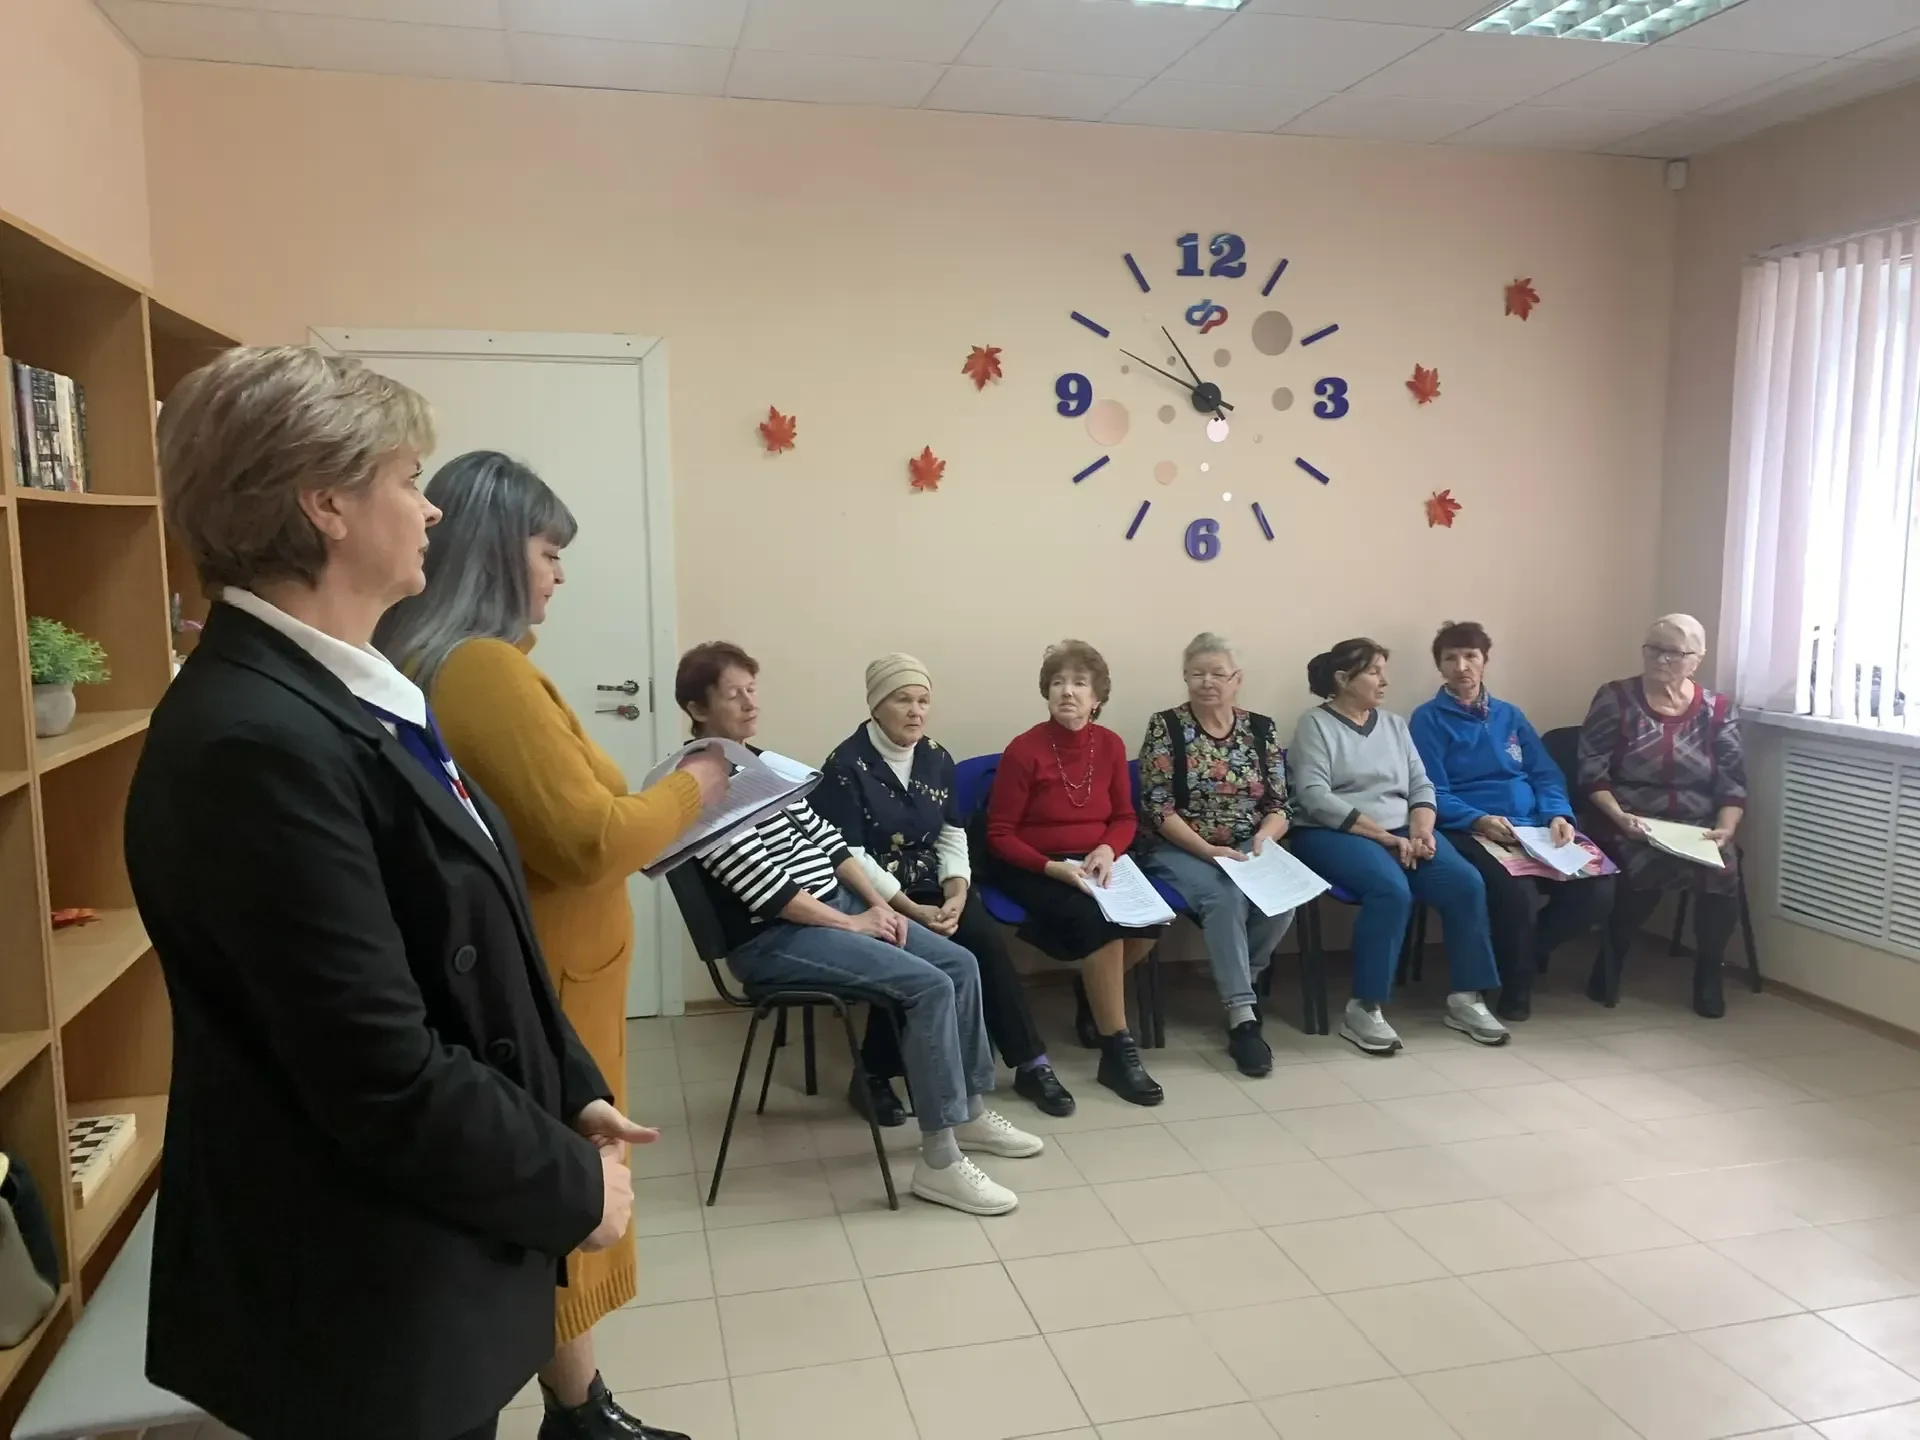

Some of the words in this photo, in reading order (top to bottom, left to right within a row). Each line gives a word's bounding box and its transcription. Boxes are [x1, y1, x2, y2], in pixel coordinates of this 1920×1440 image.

[1176, 233, 1247, 278] 12
[1055, 373, 1092, 417] 9
[1313, 377, 1350, 419] 3
[1184, 518, 1221, 561] 6
